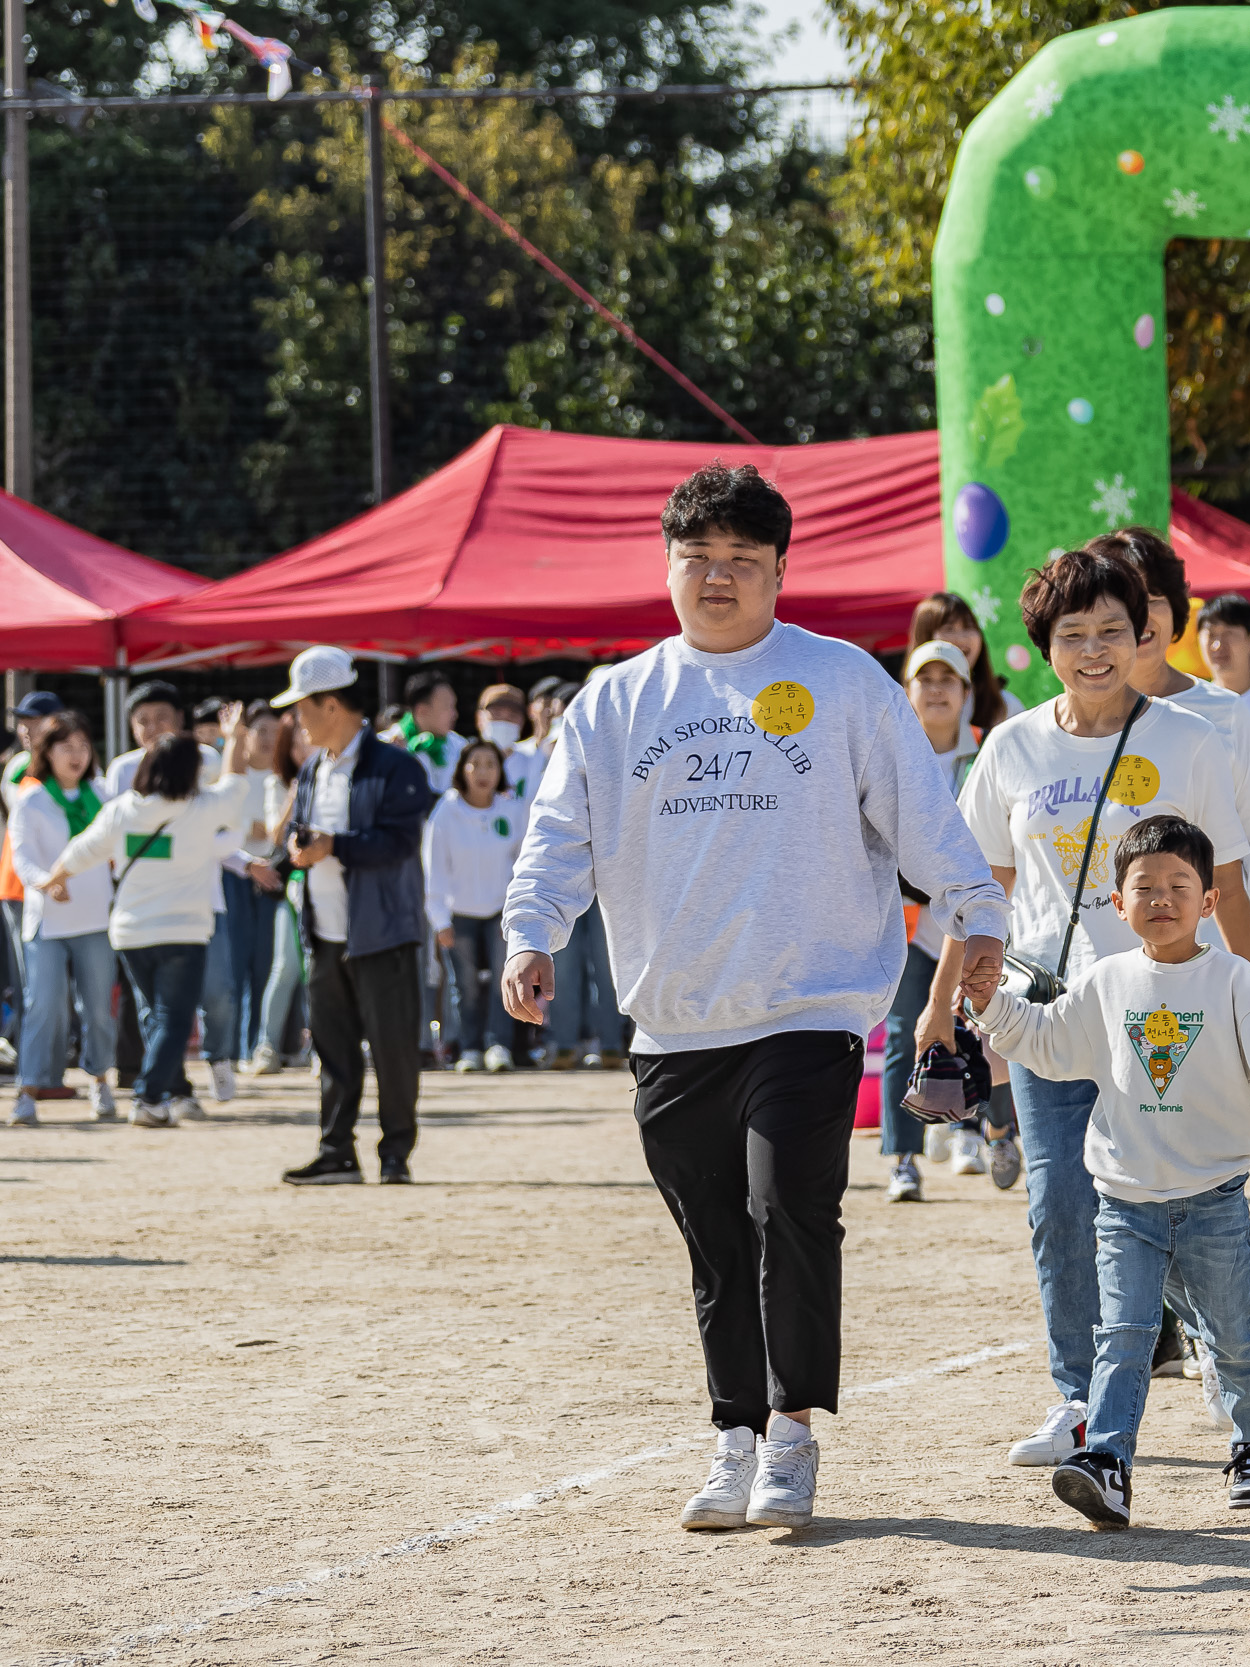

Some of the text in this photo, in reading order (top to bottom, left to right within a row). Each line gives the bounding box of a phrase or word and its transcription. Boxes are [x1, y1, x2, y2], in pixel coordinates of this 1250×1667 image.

[768, 682, 800, 699] 으뜸
[757, 702, 807, 721] 전서후
[774, 721, 792, 732] 가족
[631, 716, 812, 783] BVM SPORTS CLUB
[685, 750, 753, 782] 24/7
[1119, 756, 1144, 769] 으뜸
[659, 793, 779, 816] ADVENTURE
[1027, 776, 1141, 820] BRILLA
[1125, 1009, 1204, 1023] Tourment
[1146, 1026, 1175, 1040] 전서후
[1139, 1103, 1184, 1114] Play Tennis
